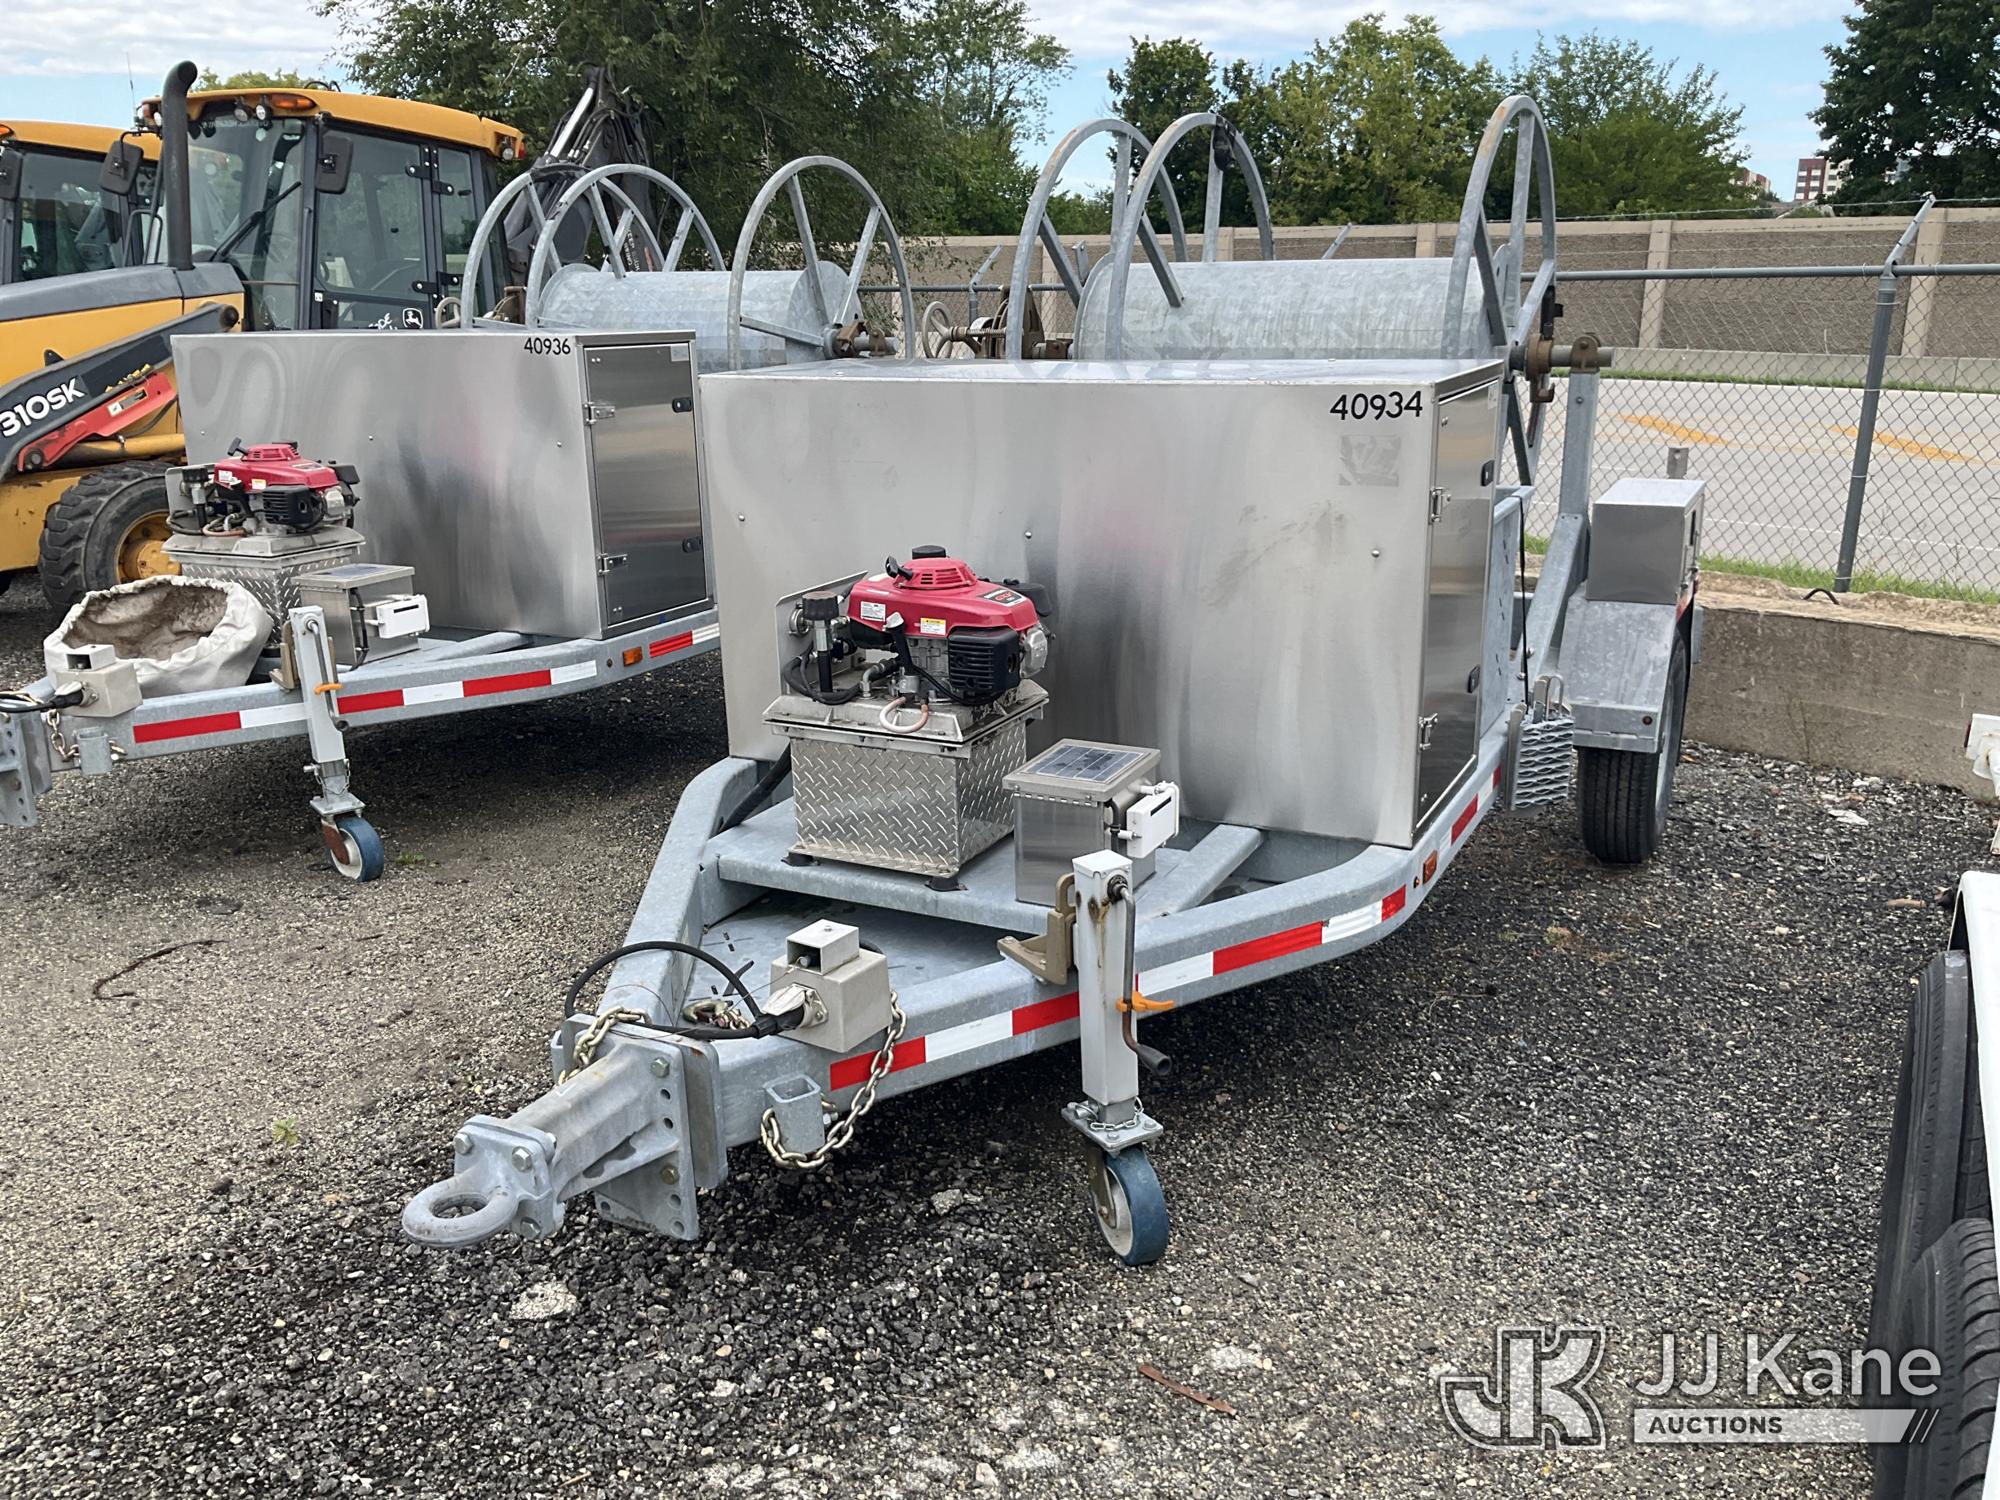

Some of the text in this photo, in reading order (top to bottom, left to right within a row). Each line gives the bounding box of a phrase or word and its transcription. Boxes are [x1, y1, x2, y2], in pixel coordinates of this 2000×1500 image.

[523, 337, 571, 355] 40936
[0, 378, 85, 437] 310SK
[1329, 390, 1423, 421] 40934
